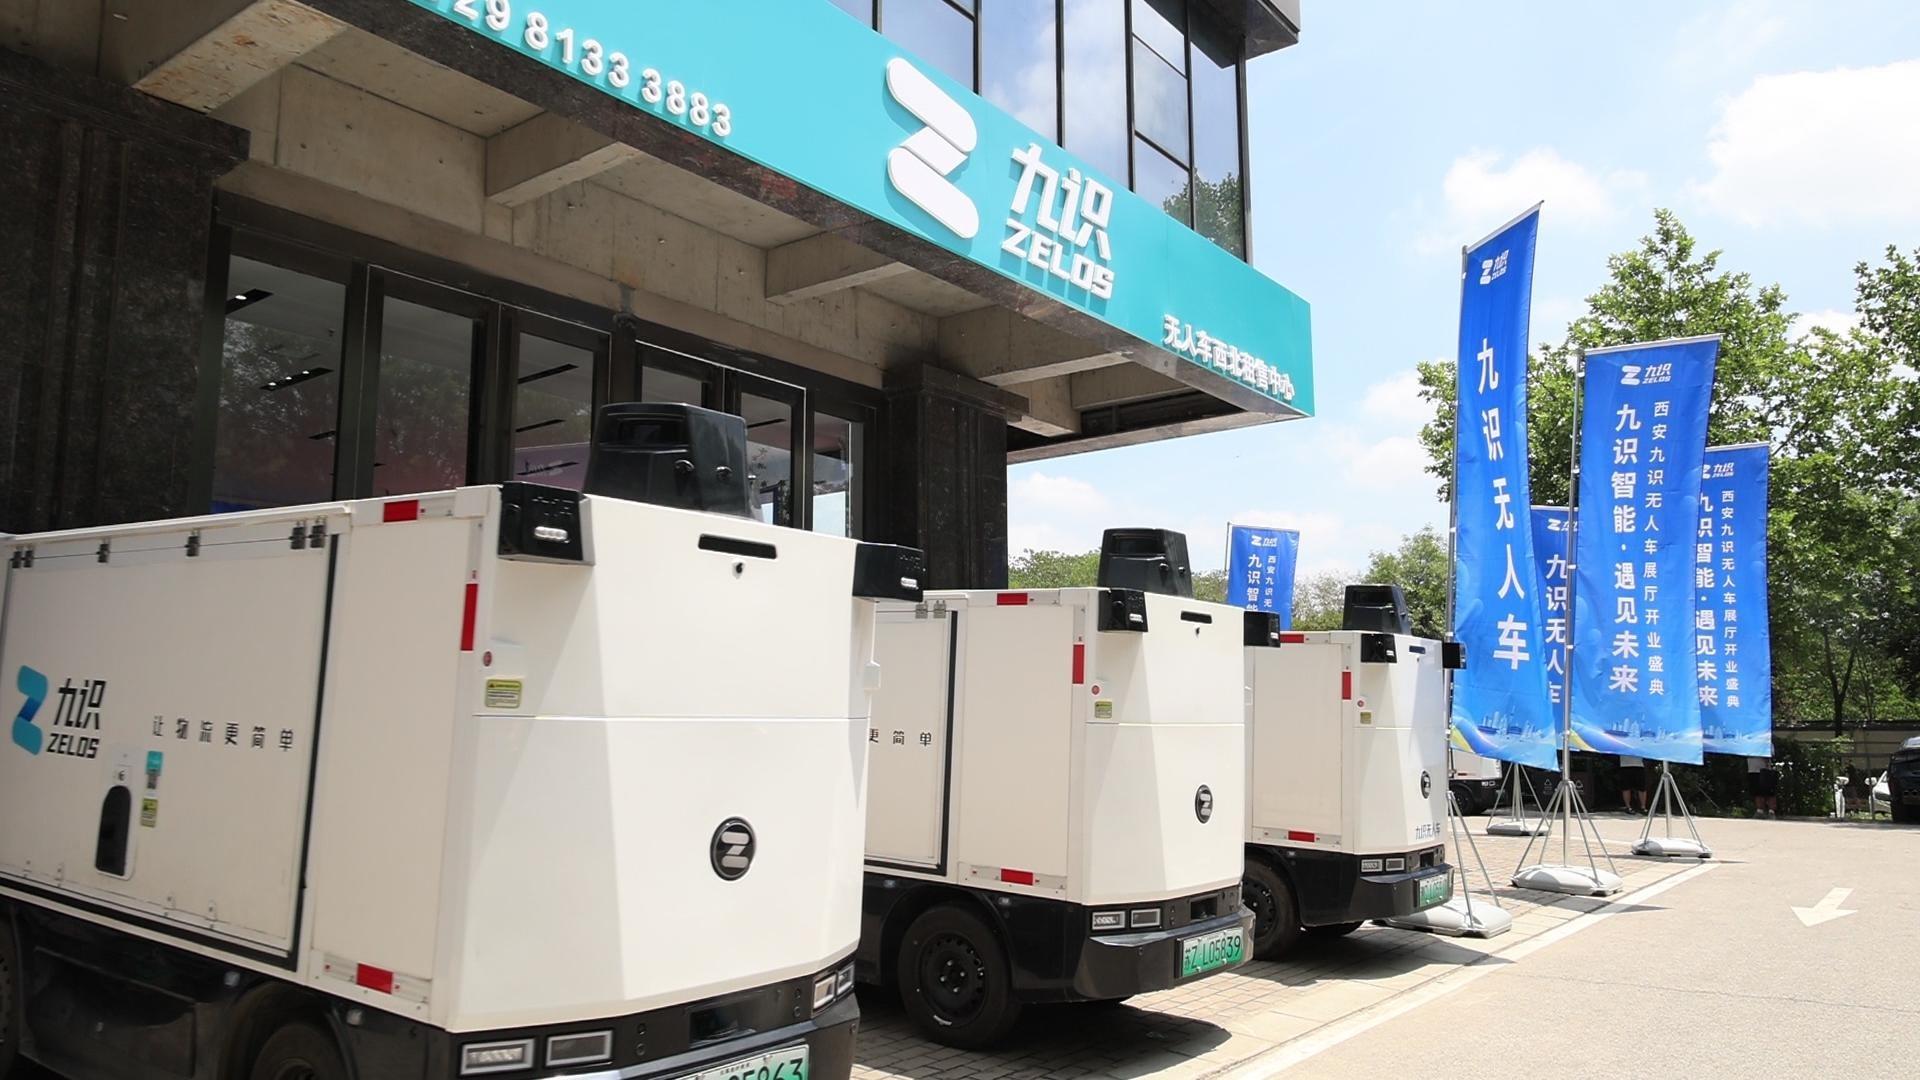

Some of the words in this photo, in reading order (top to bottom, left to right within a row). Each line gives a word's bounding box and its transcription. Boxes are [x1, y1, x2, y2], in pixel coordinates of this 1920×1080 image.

[525, 12, 630, 88] 8133
[641, 68, 732, 137] 3883
[1002, 217, 1114, 299] ZELOS
[1010, 142, 1114, 260] 九识
[1645, 363, 1672, 377] 九识
[1477, 338, 1530, 670] 九识无人车
[1643, 401, 1669, 695] 西安九识无人车展厅开业盛典
[1721, 490, 1740, 707] 西安九识无人车展厅开业盛典
[46, 732, 100, 759] ZELOS
[54, 678, 106, 730] 九识
